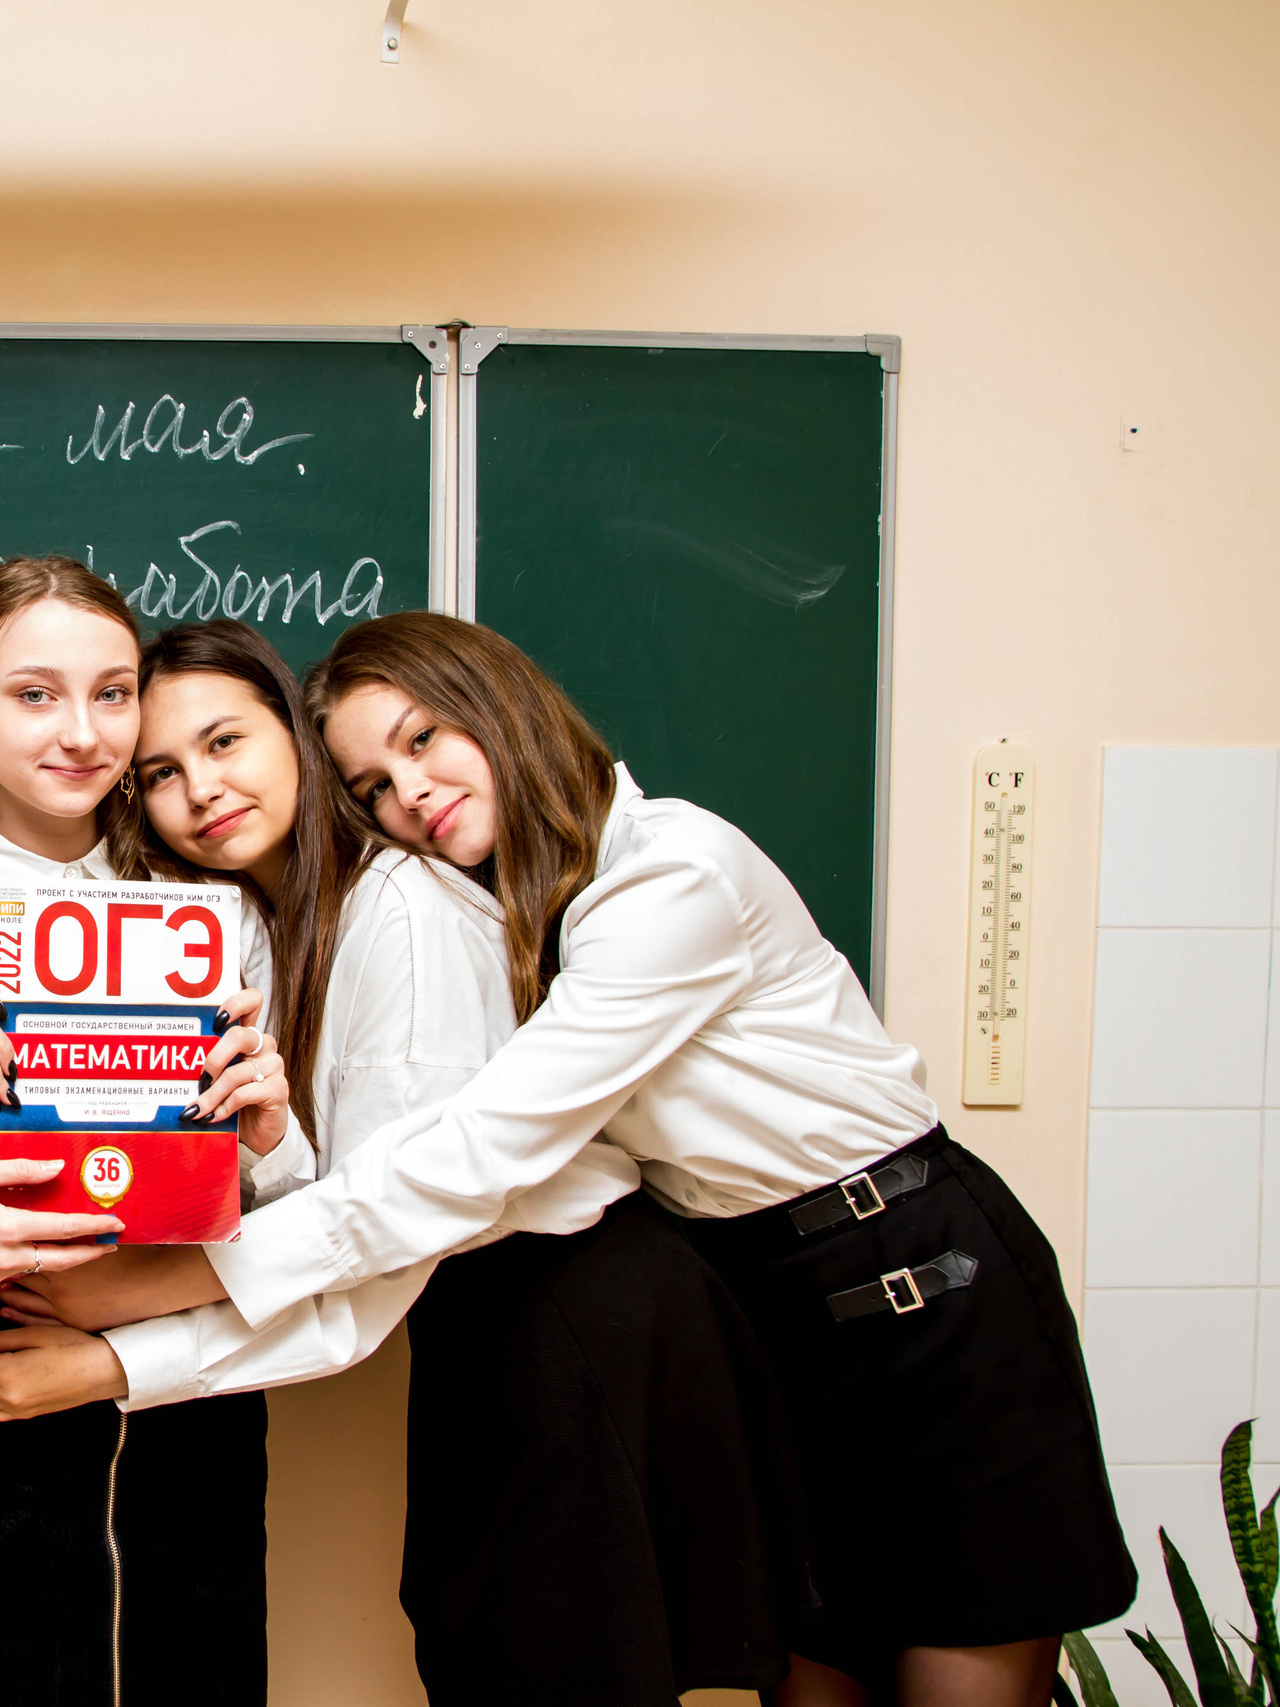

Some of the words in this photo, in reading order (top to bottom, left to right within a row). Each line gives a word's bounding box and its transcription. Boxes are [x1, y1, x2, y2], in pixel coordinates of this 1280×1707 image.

[984, 802, 996, 810] 50
[1012, 805, 1026, 813] 120
[983, 828, 995, 836] 40
[1011, 834, 1025, 842] 100
[982, 854, 994, 862] 30
[1011, 863, 1023, 871] 80
[36, 888, 66, 897] ПРОЕКТ
[69, 889, 74, 898] С
[77, 889, 118, 899] УЧАСТИЕМ
[121, 891, 184, 901] РАЗРАБОТЧИКОВ
[187, 894, 203, 902] КИМ
[206, 894, 221, 903] ОГЭ
[1010, 892, 1022, 900] 60
[981, 906, 992, 914] 10
[1009, 921, 1021, 929] 40
[982, 932, 989, 941] 0
[34, 900, 223, 999] ОГЭ
[1008, 950, 1020, 958] 20
[979, 958, 990, 966] 10
[1009, 978, 1016, 987] 0
[978, 984, 989, 993] 20
[977, 1010, 988, 1019] 30
[1006, 1007, 1017, 1016] 20
[23, 1020, 68, 1029] ОСНОВНОЙ
[71, 1020, 153, 1031] ГОСУДАРСТВЕННЫЙ
[156, 1023, 195, 1031] ЭКЗАМЕН
[14, 1043, 207, 1070] МАТЕМАТИКА
[24, 1086, 61, 1095] ТИПОВЫЕ
[65, 1086, 144, 1097] ЭКЗАМЕНАЦИОННЫЕ
[148, 1087, 190, 1096] ВАРИАНТЫ
[101, 1109, 131, 1117] ЯЩЕНКО
[93, 1157, 120, 1182] 36
